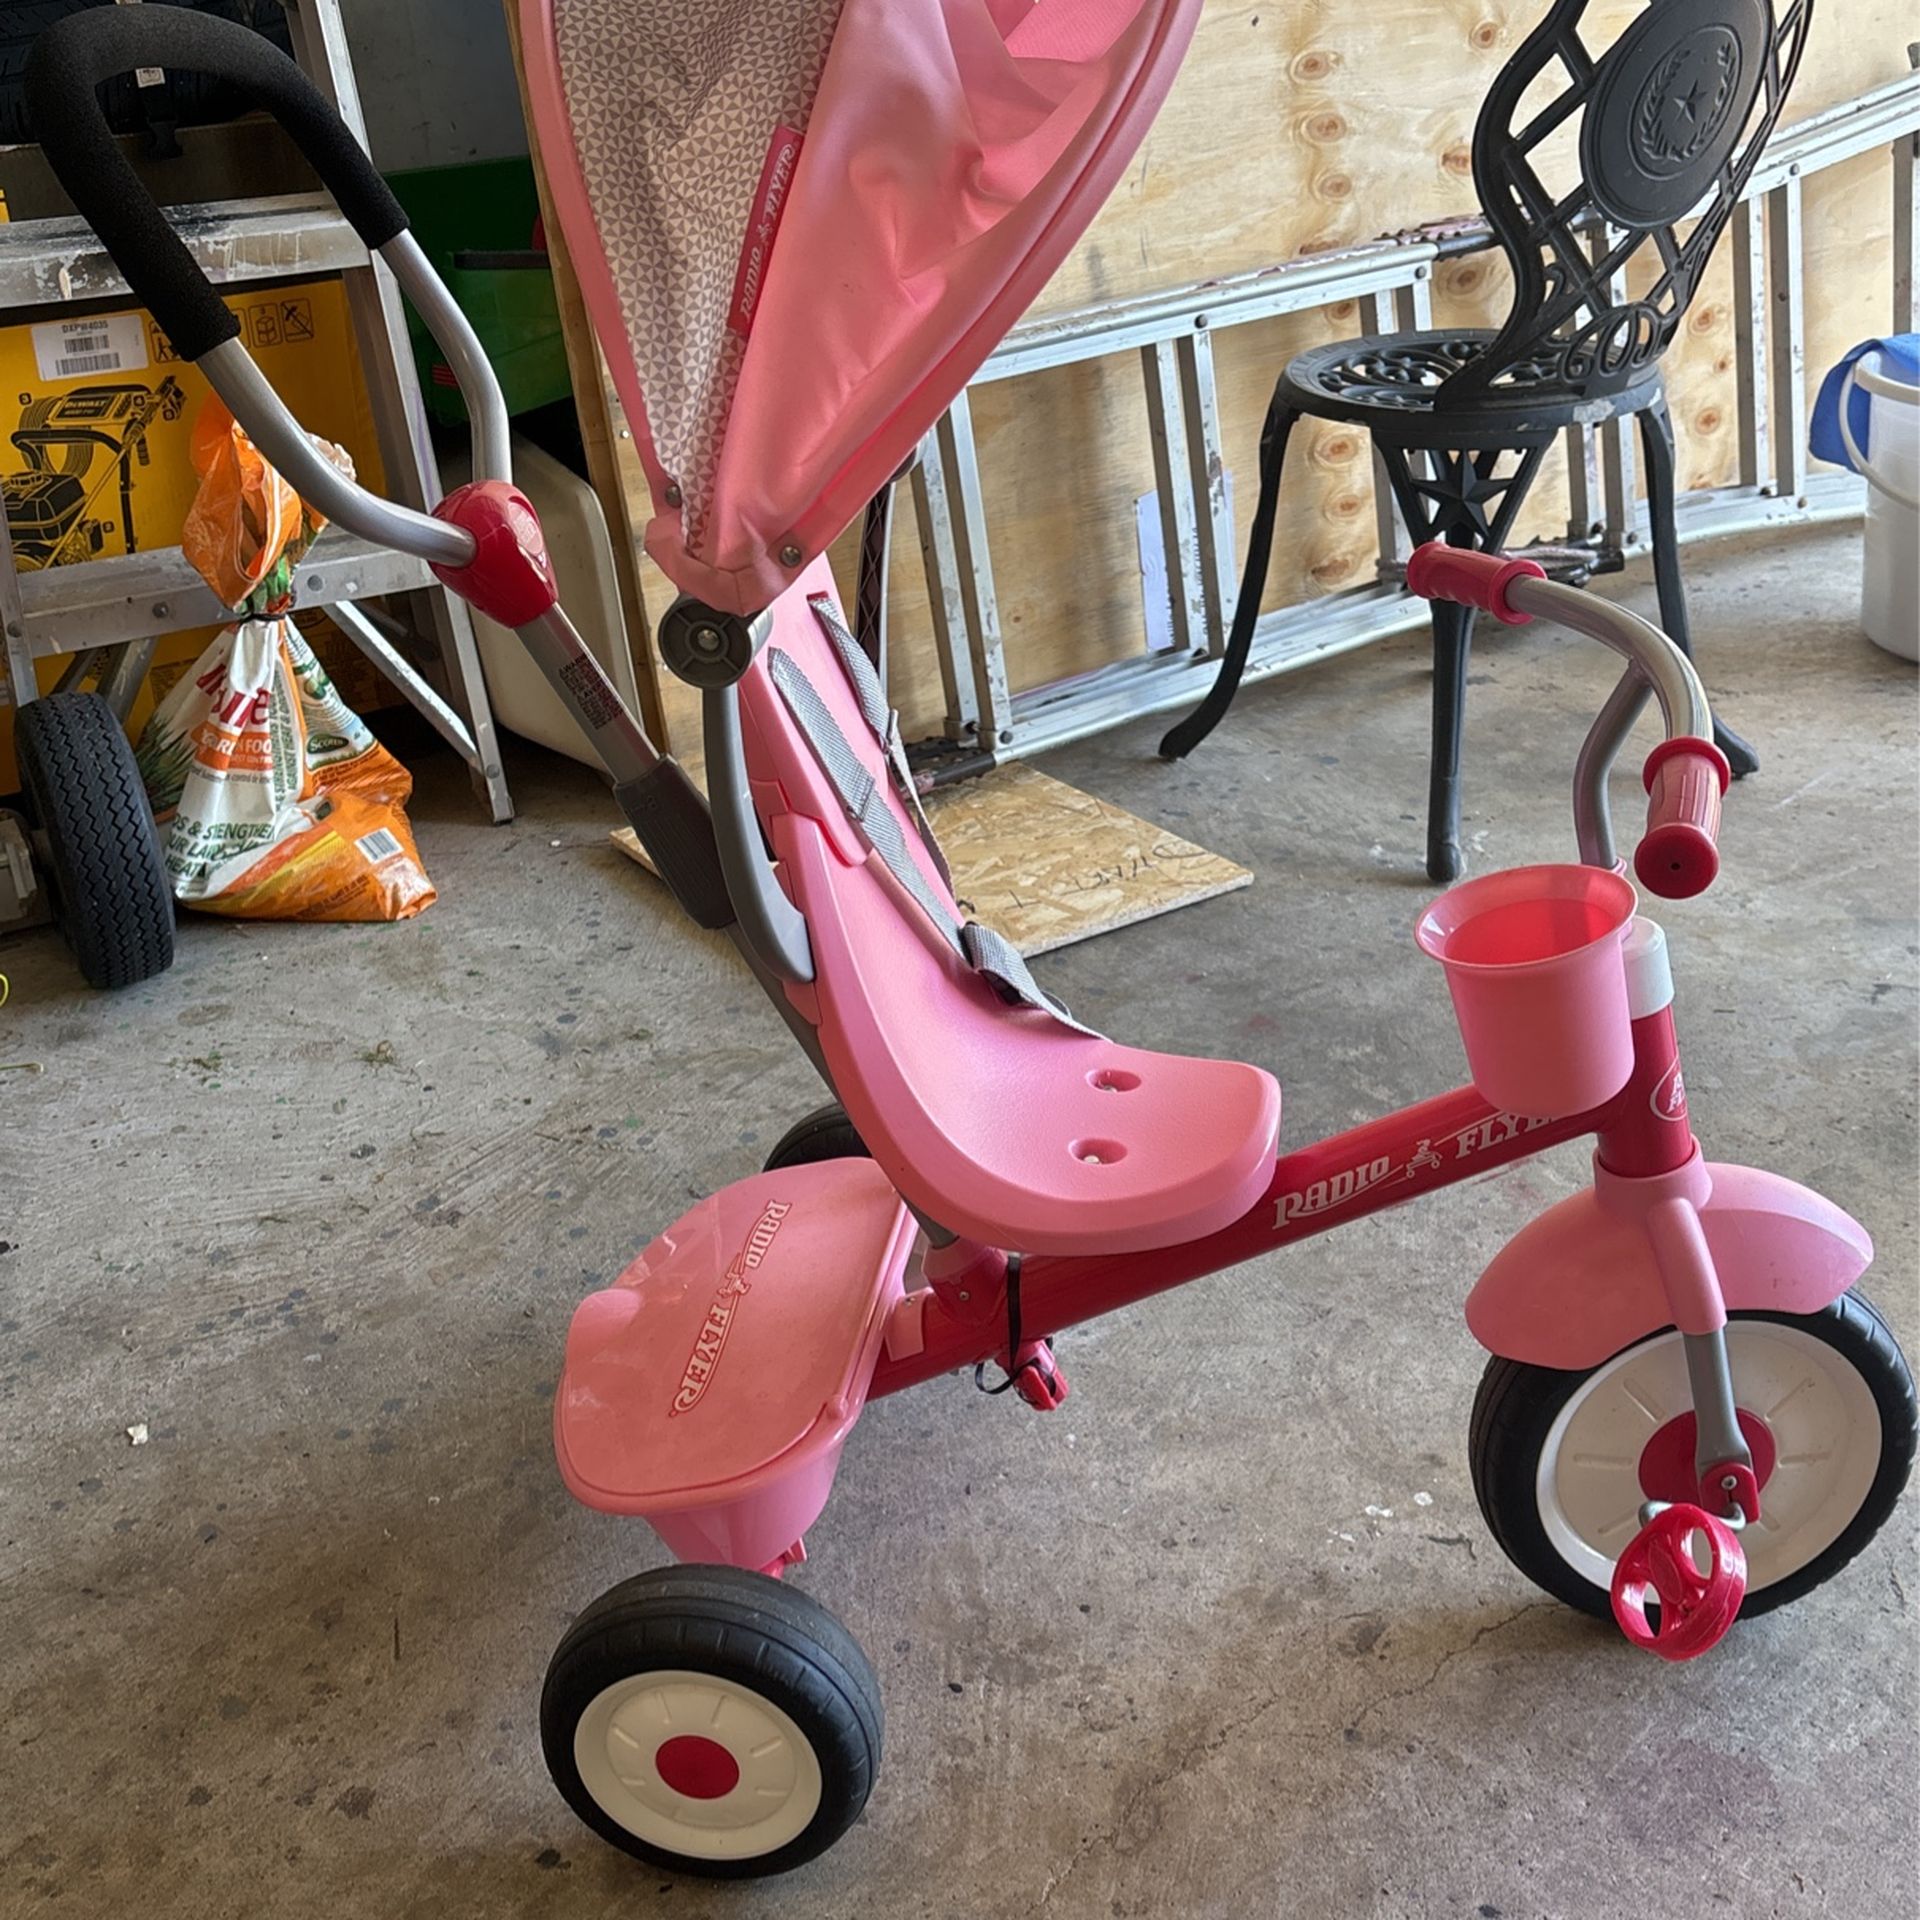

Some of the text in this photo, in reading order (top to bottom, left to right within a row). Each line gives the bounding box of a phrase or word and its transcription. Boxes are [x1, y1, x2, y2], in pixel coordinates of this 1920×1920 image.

[740, 143, 796, 321] RADIO FLYER
[188, 820, 202, 836] &
[1271, 1156, 1390, 1230] RADIO
[673, 1199, 792, 1412] RADIO FLYER
